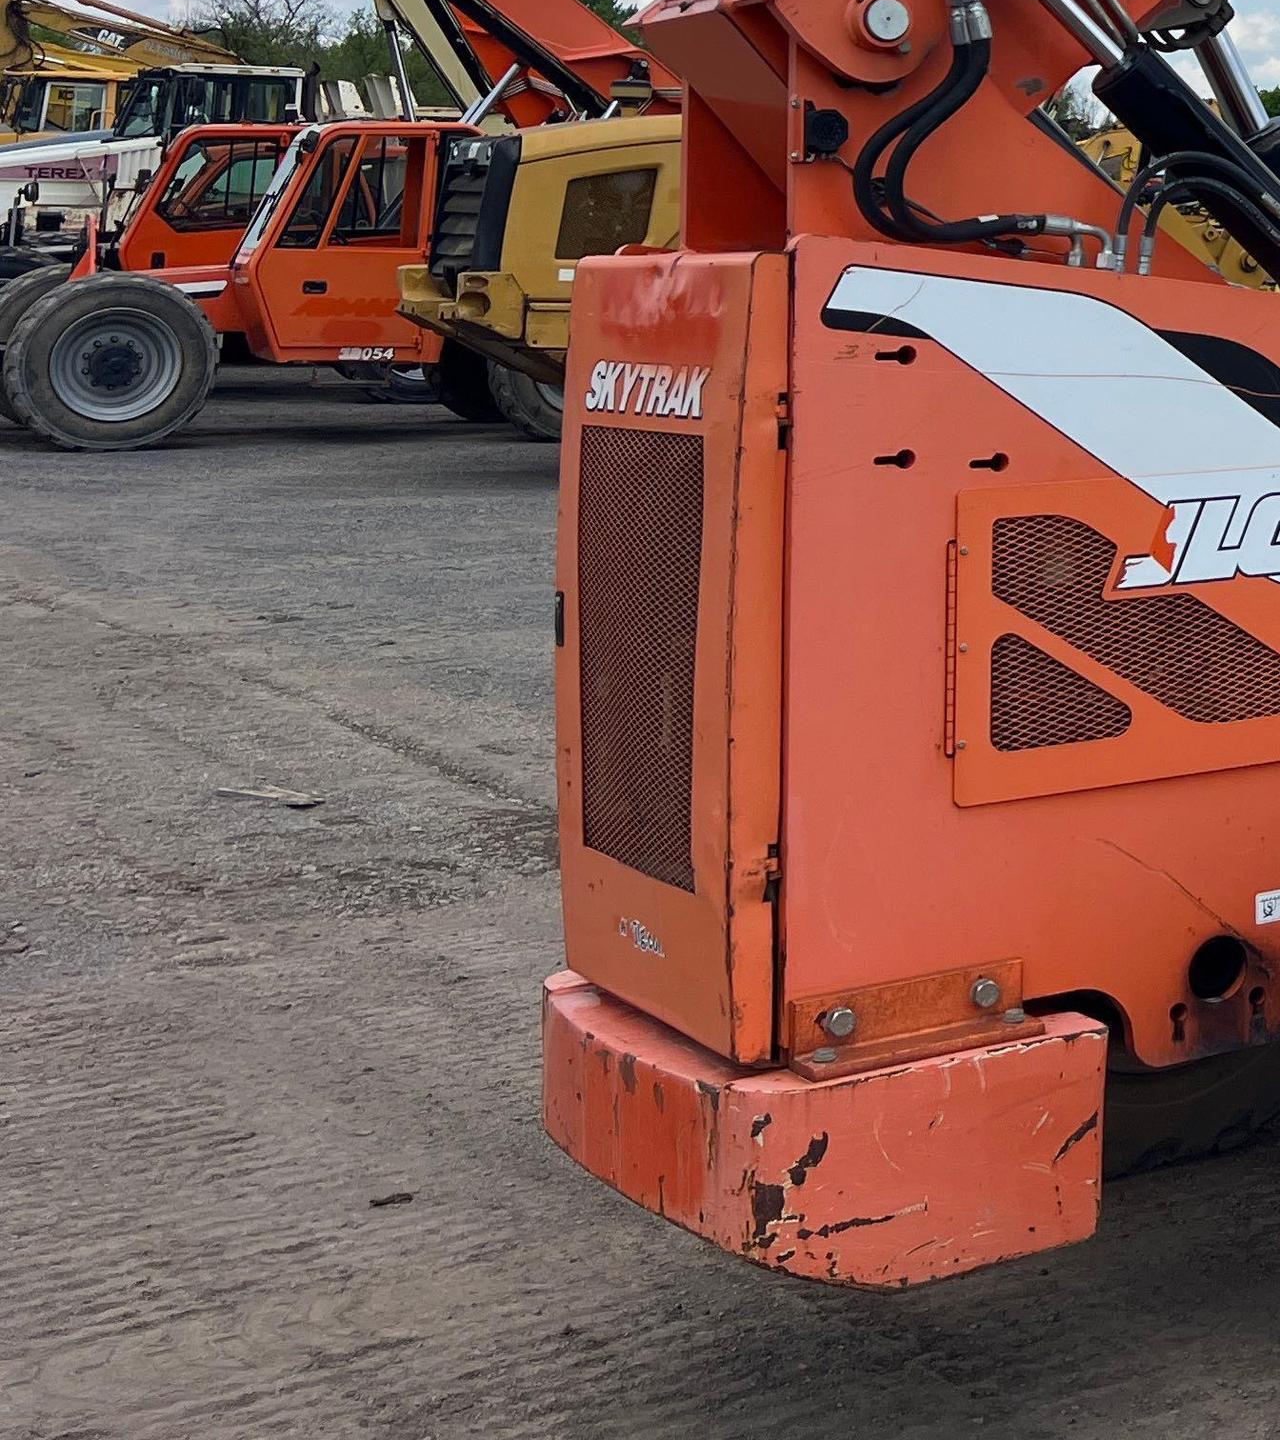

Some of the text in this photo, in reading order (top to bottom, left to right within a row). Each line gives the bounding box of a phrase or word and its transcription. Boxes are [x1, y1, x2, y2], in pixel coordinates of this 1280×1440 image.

[96, 29, 125, 50] CAT
[24, 167, 93, 179] TEREX
[585, 360, 711, 420] SKYTRAK
